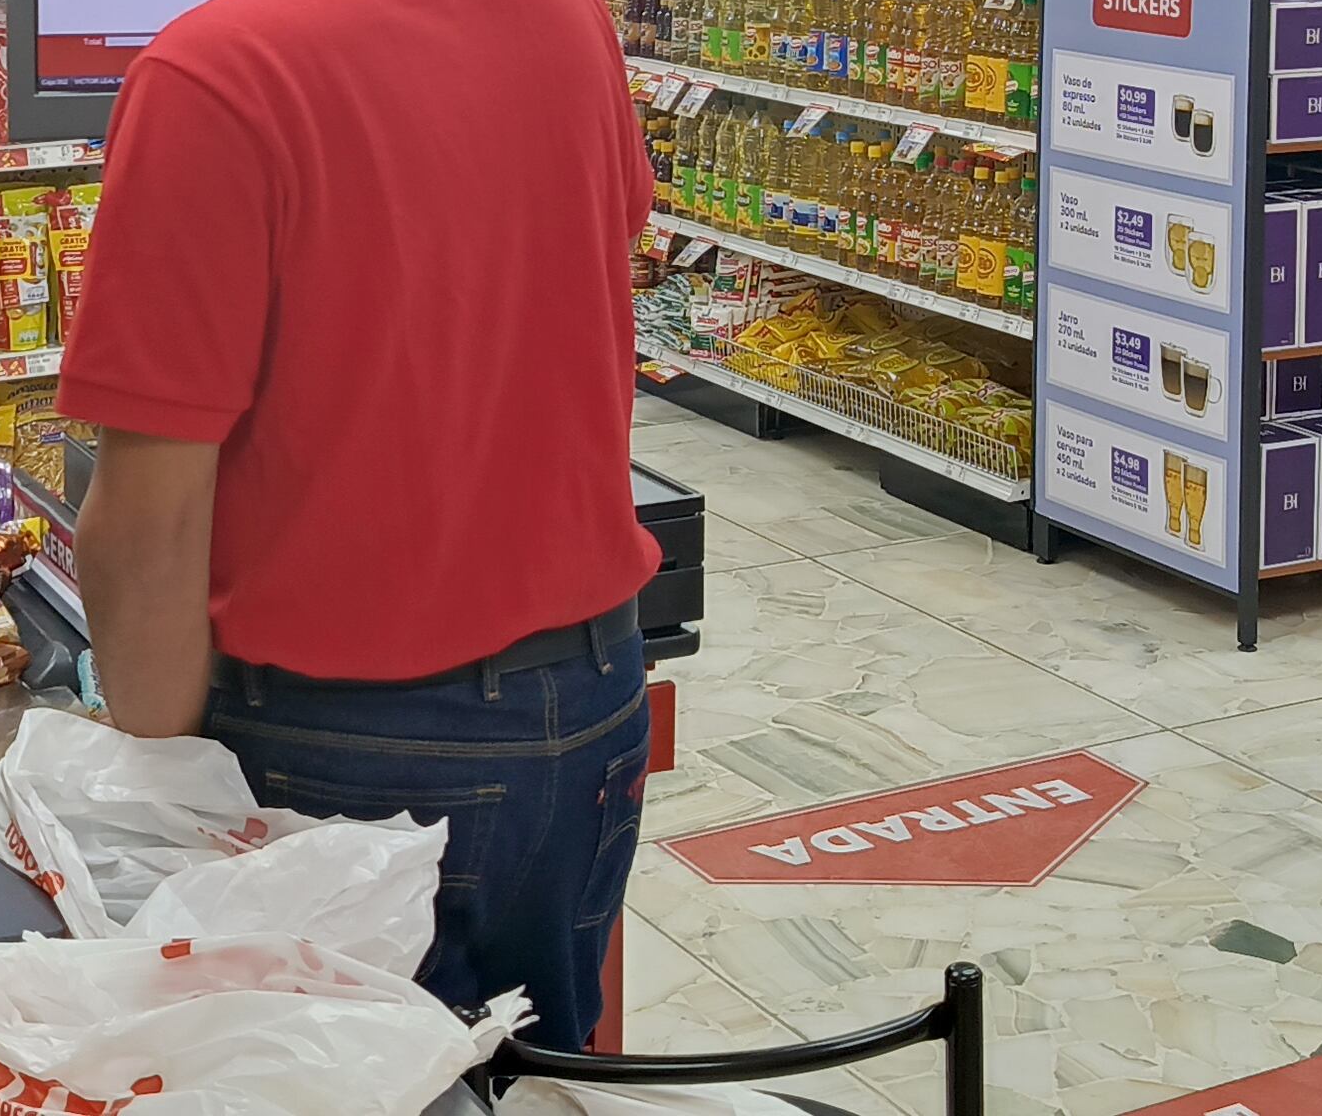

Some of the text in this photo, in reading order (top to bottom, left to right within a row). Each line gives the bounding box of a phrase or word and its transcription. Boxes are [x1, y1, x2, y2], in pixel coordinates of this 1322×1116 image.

[1062, 74, 1092, 89] Vaso de
[1119, 87, 1147, 104] $0,99
[1072, 117, 1102, 132] unidades
[1060, 192, 1079, 206] Vaso
[1060, 205, 1076, 218] 300
[1117, 209, 1144, 228] $2,49
[1070, 223, 1099, 238] unidades
[1058, 310, 1079, 325] Jarro
[1058, 323, 1072, 337] 270
[1115, 331, 1141, 350] $3,49
[1067, 342, 1097, 358] unidades
[1056, 424, 1094, 448] Vaso para
[1056, 440, 1086, 458] cerveza
[1113, 450, 1140, 471] $4,98
[1066, 470, 1097, 489] unidades
[747, 778, 1094, 866] ENTRADA
